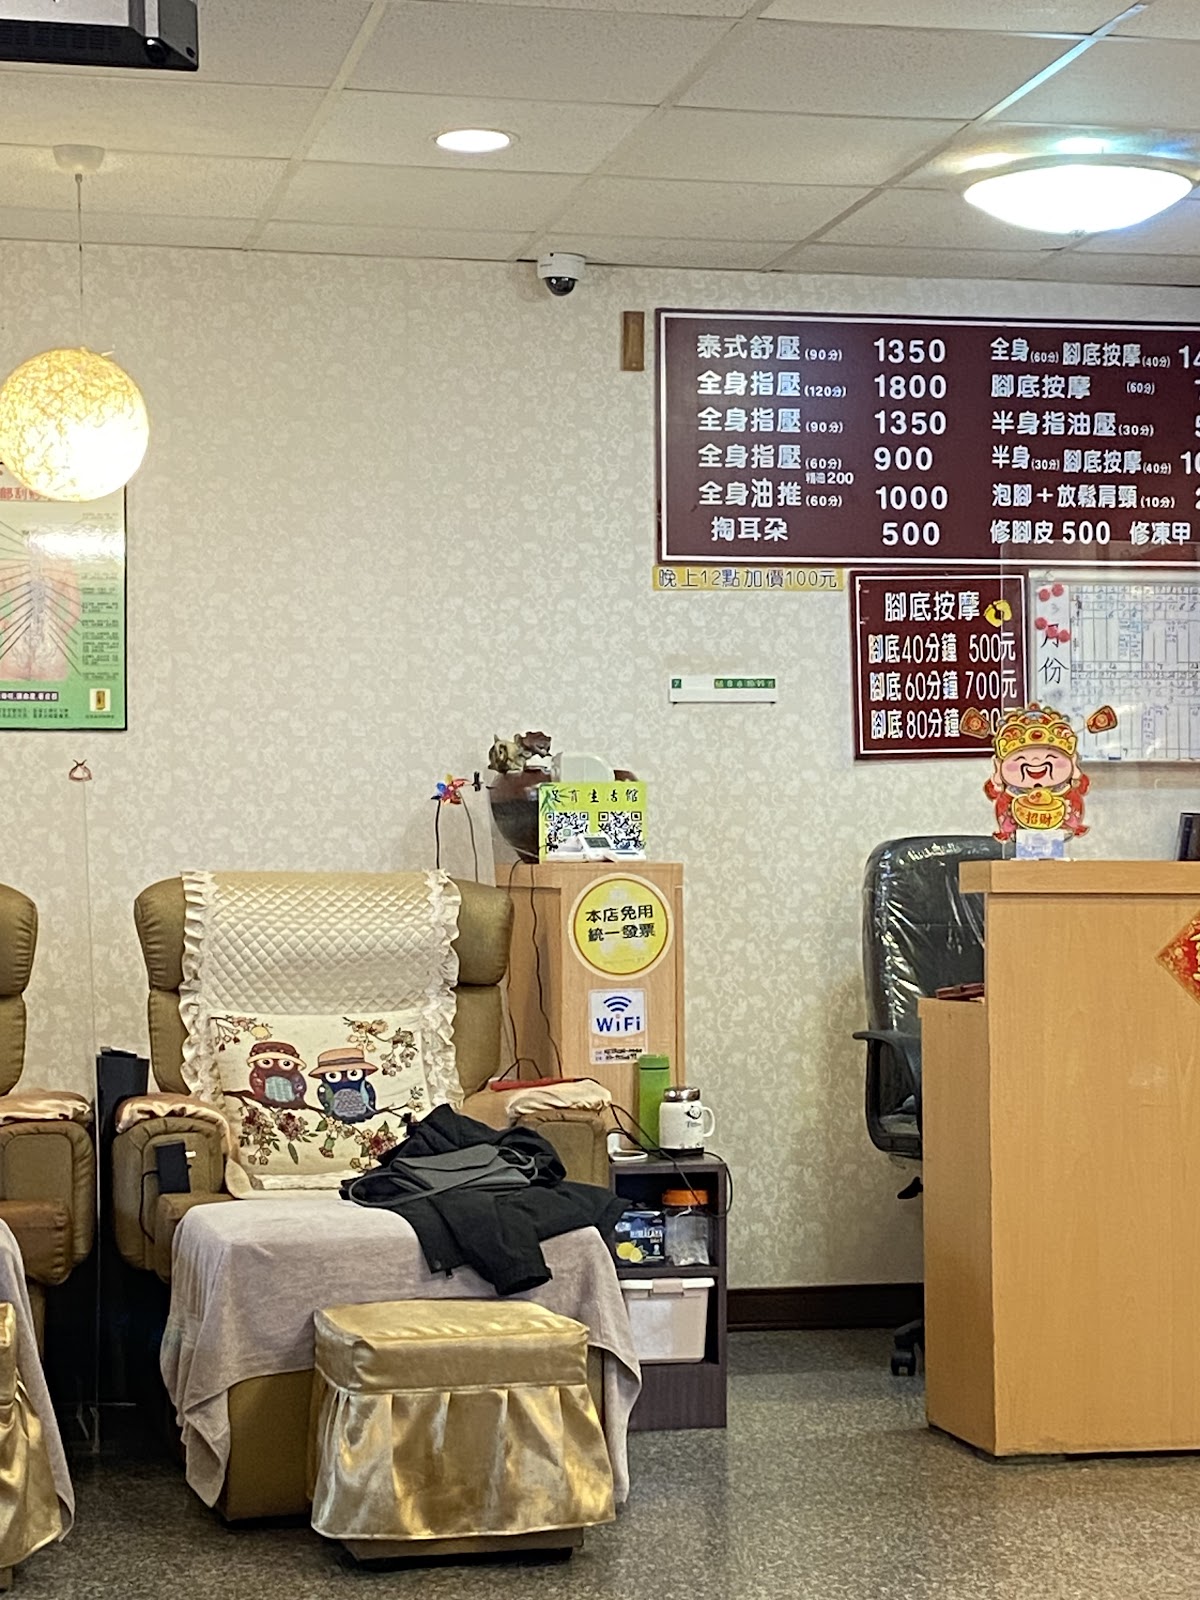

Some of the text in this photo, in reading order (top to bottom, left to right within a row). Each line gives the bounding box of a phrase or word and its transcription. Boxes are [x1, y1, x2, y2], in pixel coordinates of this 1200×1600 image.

[697, 334, 946, 363] 泰式舒壓 (90分) 1350
[990, 337, 1030, 361] 全身
[1062, 342, 1141, 367] 腳底按摩
[697, 370, 946, 399] 全身指壓 (120分) 1800
[990, 374, 1091, 399] 腳底按摩
[697, 406, 946, 435] 全身指壓 (90分) 1350
[991, 410, 1117, 436] 半身指油壓
[698, 443, 933, 471] 全身指壓 (60分) 900
[991, 444, 1031, 470] 半身
[1062, 450, 1142, 474] 腳底按摩
[698, 478, 948, 510] 全身油推 (60分) 1000
[711, 516, 940, 546] 掏耳朵 500
[990, 520, 1054, 544] 修腳皮
[1062, 521, 1111, 545] 500
[658, 569, 837, 587] 晚上12點加價100元
[884, 591, 980, 622] 腳底按摩
[969, 632, 1016, 662] 500元
[965, 669, 1017, 700] 700元
[585, 904, 654, 923] 本店免用
[587, 923, 656, 942] 統一發票
[596, 1014, 641, 1032] WiFi
